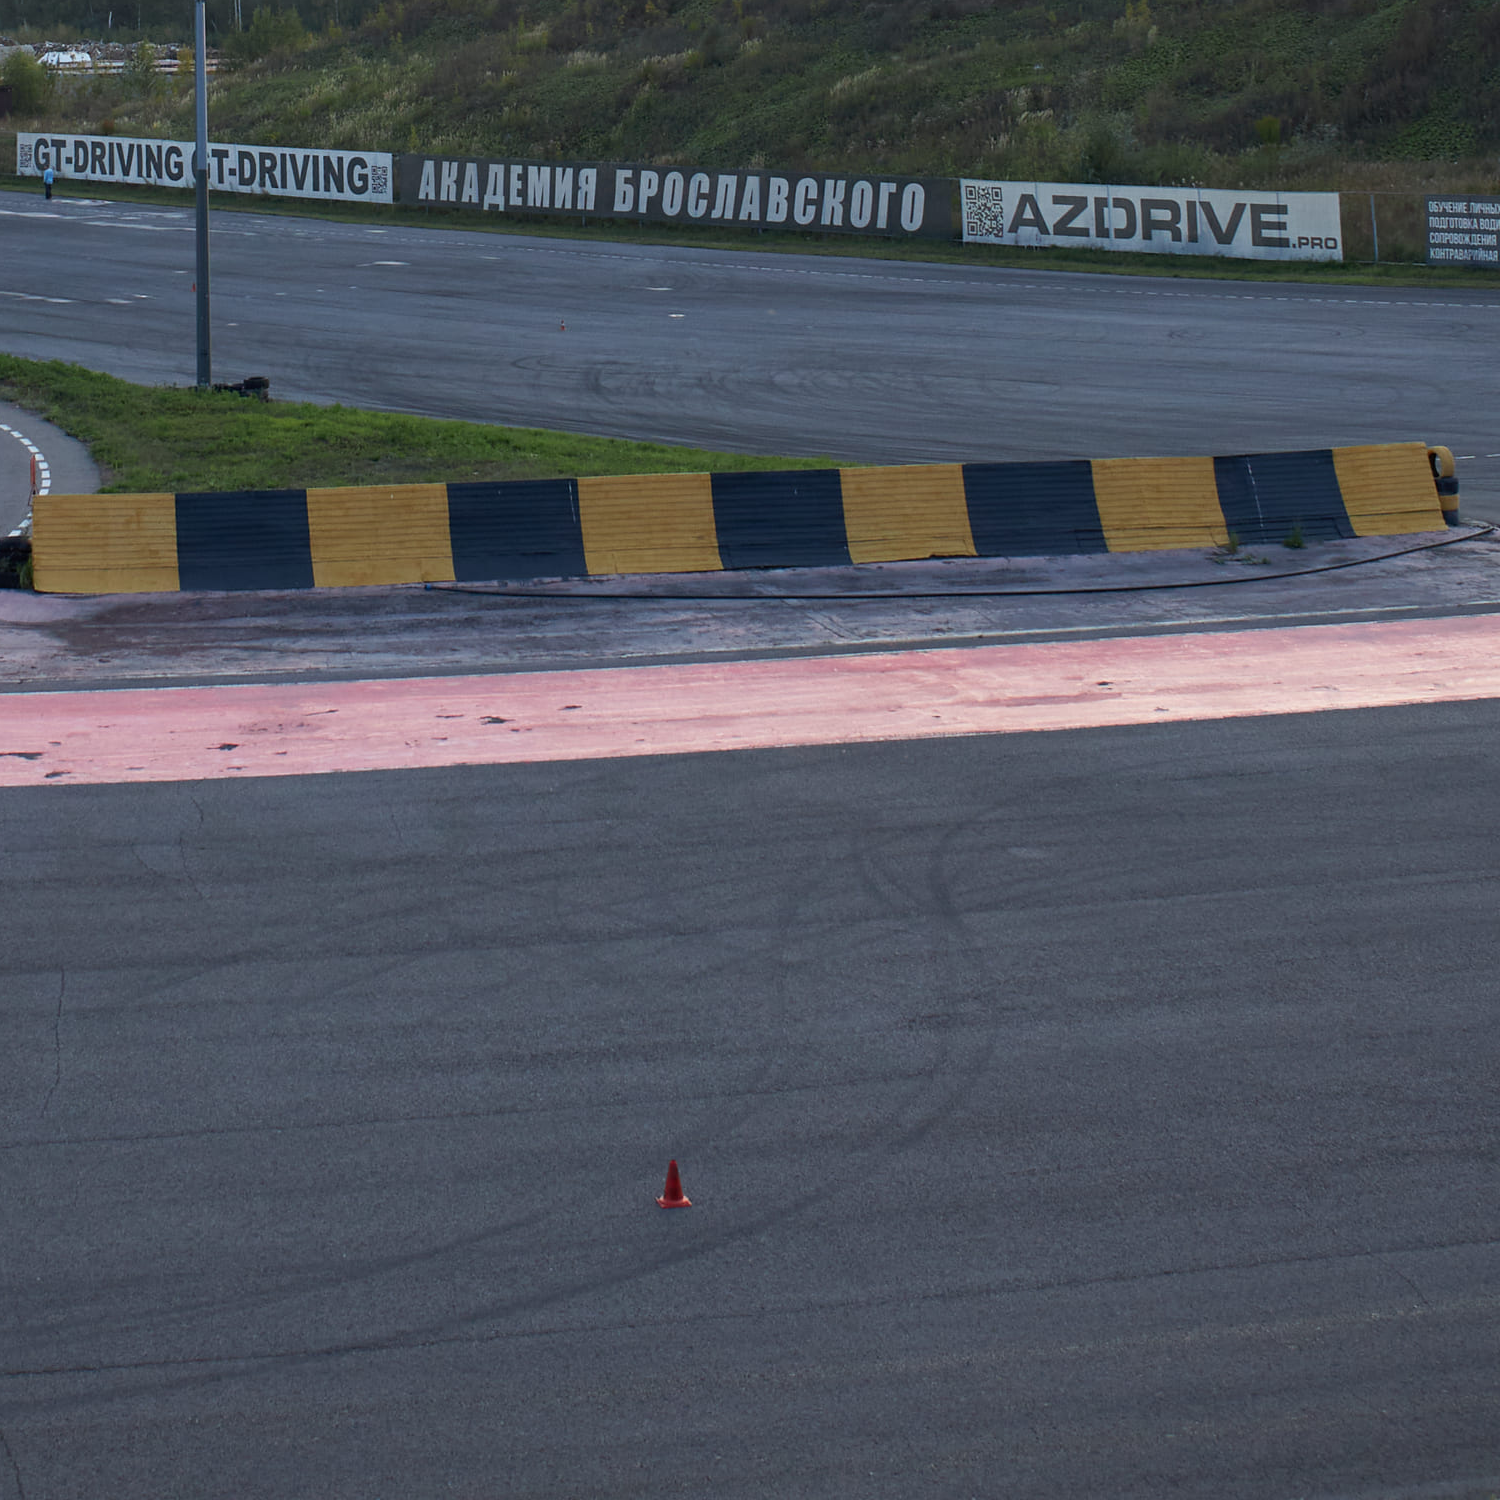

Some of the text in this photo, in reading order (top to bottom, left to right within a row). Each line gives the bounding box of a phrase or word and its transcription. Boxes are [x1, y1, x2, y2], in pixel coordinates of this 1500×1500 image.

[33, 137, 184, 182] GT-DRIVING
[418, 159, 927, 232] АКАДЕМИЯ БРОСЛАВСКОГО
[1428, 201, 1468, 214] ОБУЧЕНИЕ
[1428, 216, 1479, 230] ПОДГОТОВКА
[1429, 232, 1498, 246] СОПРОВОЖДЕНИЯ
[1429, 247, 1499, 262] КОНТРАВАРИЙНАЯ
